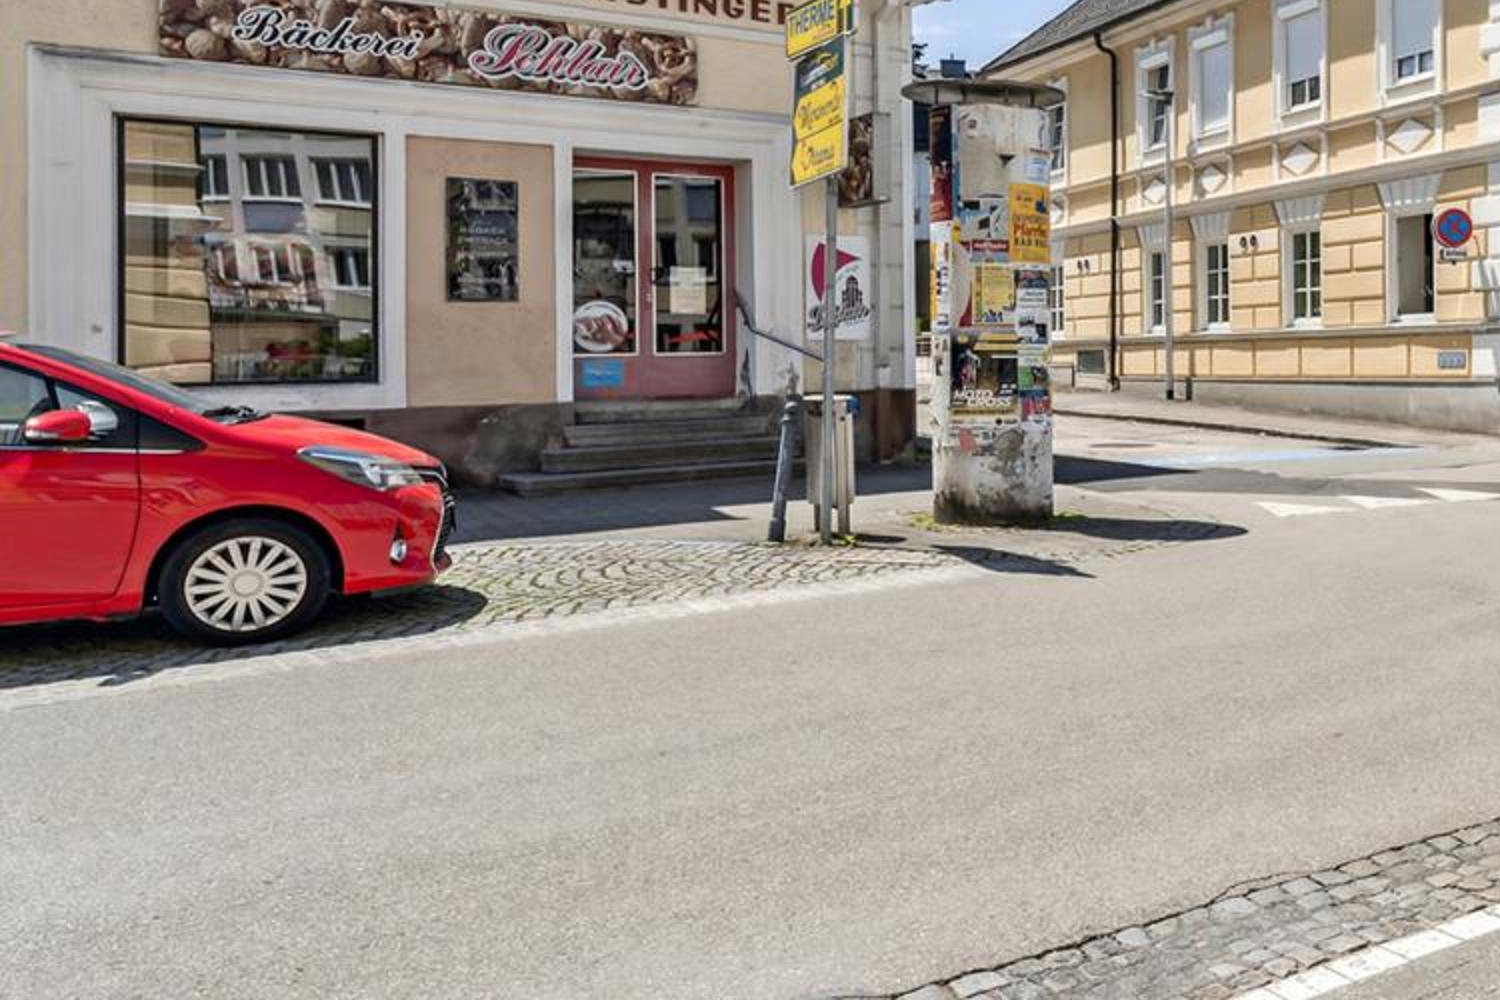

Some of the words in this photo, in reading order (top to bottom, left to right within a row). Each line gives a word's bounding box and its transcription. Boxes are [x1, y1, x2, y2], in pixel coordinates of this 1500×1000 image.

[230, 6, 423, 60] Bäckerei
[468, 23, 649, 90] Schlair
[967, 396, 1012, 408] CROSS
